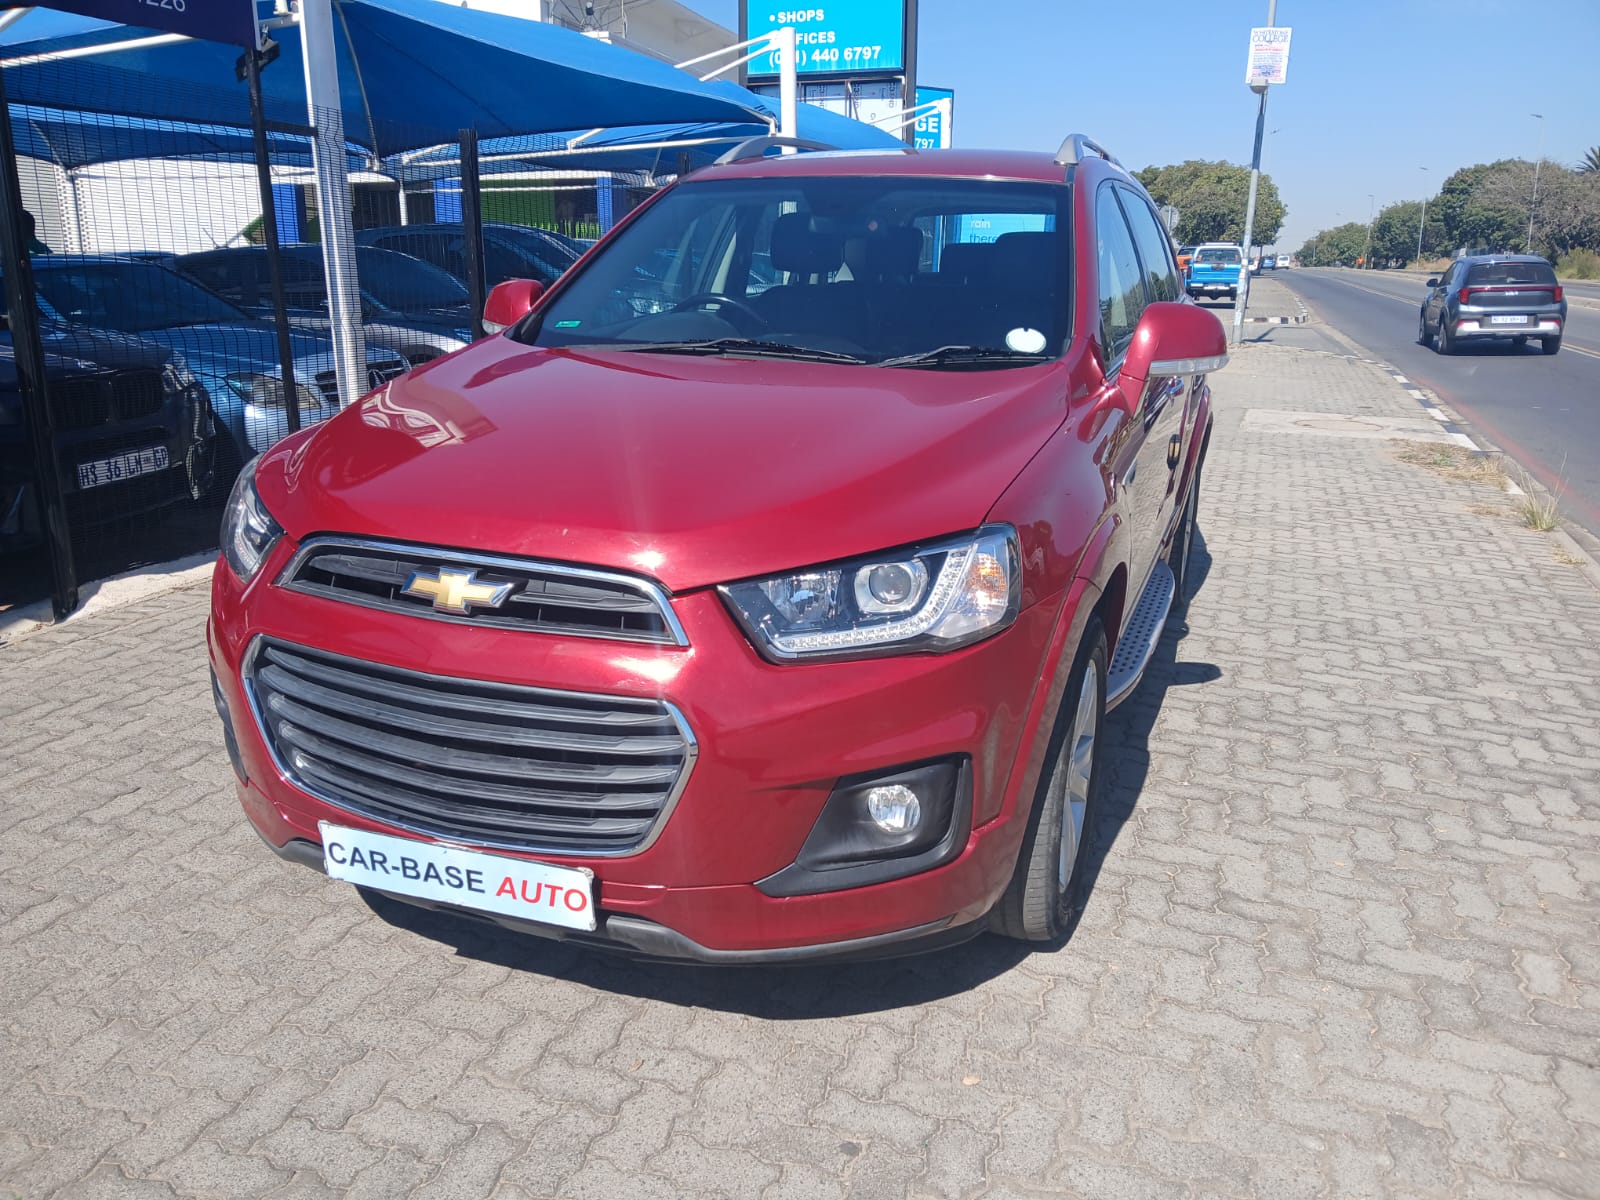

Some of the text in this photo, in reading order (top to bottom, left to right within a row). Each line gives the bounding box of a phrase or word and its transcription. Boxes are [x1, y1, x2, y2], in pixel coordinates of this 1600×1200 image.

[778, 9, 824, 23] SHOPS
[796, 31, 836, 45] FICES
[1253, 34, 1289, 42] COLLEGE
[811, 48, 839, 62] 440
[844, 45, 881, 60] 6797
[915, 117, 939, 133] GE
[914, 137, 935, 149] 797
[327, 842, 588, 912] CAR-BASE AUTO
